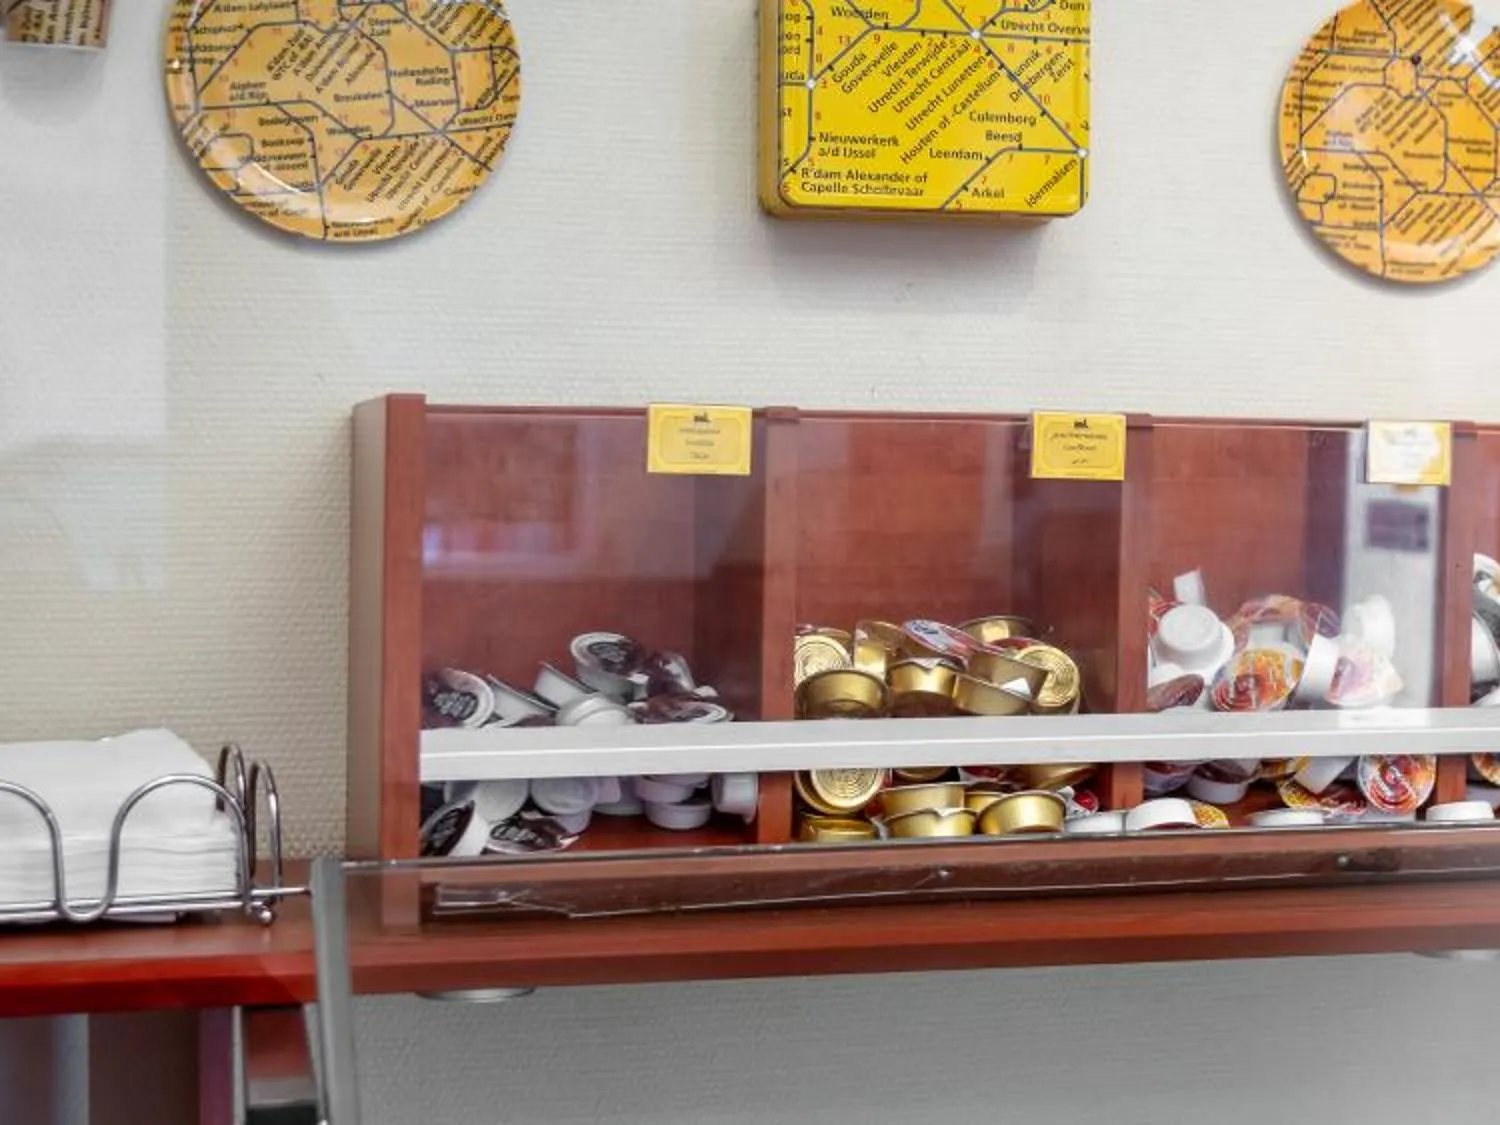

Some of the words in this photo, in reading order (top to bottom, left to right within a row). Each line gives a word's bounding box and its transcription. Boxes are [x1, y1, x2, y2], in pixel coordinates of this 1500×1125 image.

[832, 52, 868, 84] Gouda
[841, 41, 899, 94] Goverwelle
[881, 42, 923, 78] Vleuten
[892, 77, 931, 114] Utrecht
[929, 39, 972, 80] Centraal
[867, 78, 908, 114] Utrecht
[905, 94, 944, 132] Utrecht
[942, 54, 987, 98] Lunetten
[818, 131, 900, 148] Nieuwerkerk
[899, 128, 940, 166] Houten
[985, 129, 1023, 143] Beesd
[929, 147, 983, 161] Leerdam
[800, 181, 849, 195] Capelle
[845, 168, 911, 184] Alexander
[971, 186, 1005, 199] Arkel
